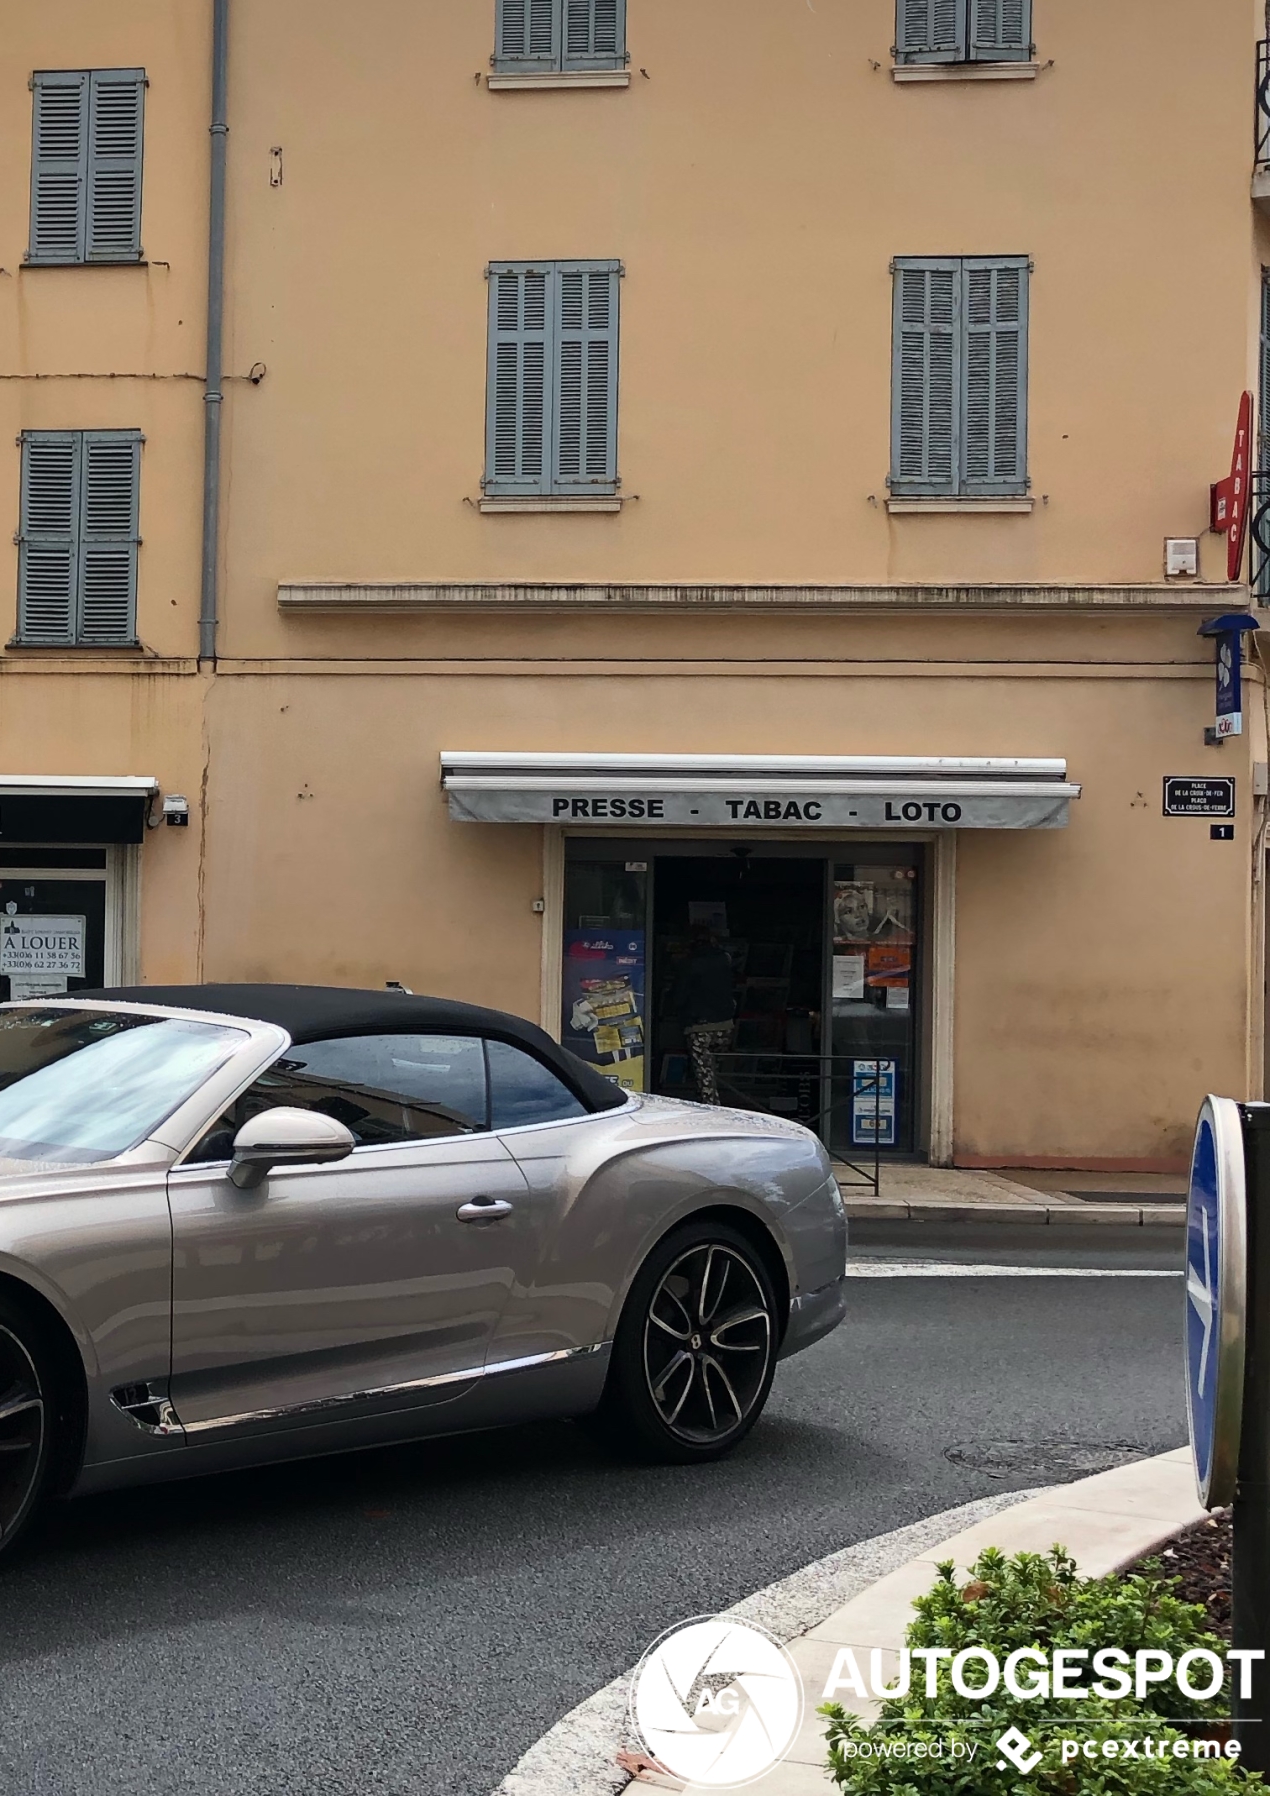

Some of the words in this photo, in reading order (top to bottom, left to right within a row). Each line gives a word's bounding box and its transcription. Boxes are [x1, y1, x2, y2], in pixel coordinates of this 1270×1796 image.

[1230, 429, 1245, 542] TABAC
[552, 799, 664, 818] PRESSE
[726, 800, 822, 820] TABAC
[885, 801, 961, 822] LOTO
[174, 814, 181, 823] 3
[1218, 827, 1225, 837] 1
[4, 936, 16, 950] A
[21, 936, 79, 950] LOUER
[71, 952, 80, 960] 56
[34, 961, 44, 969] 62
[46, 961, 56, 969] 27
[58, 961, 68, 969] 36
[71, 961, 80, 969] 72
